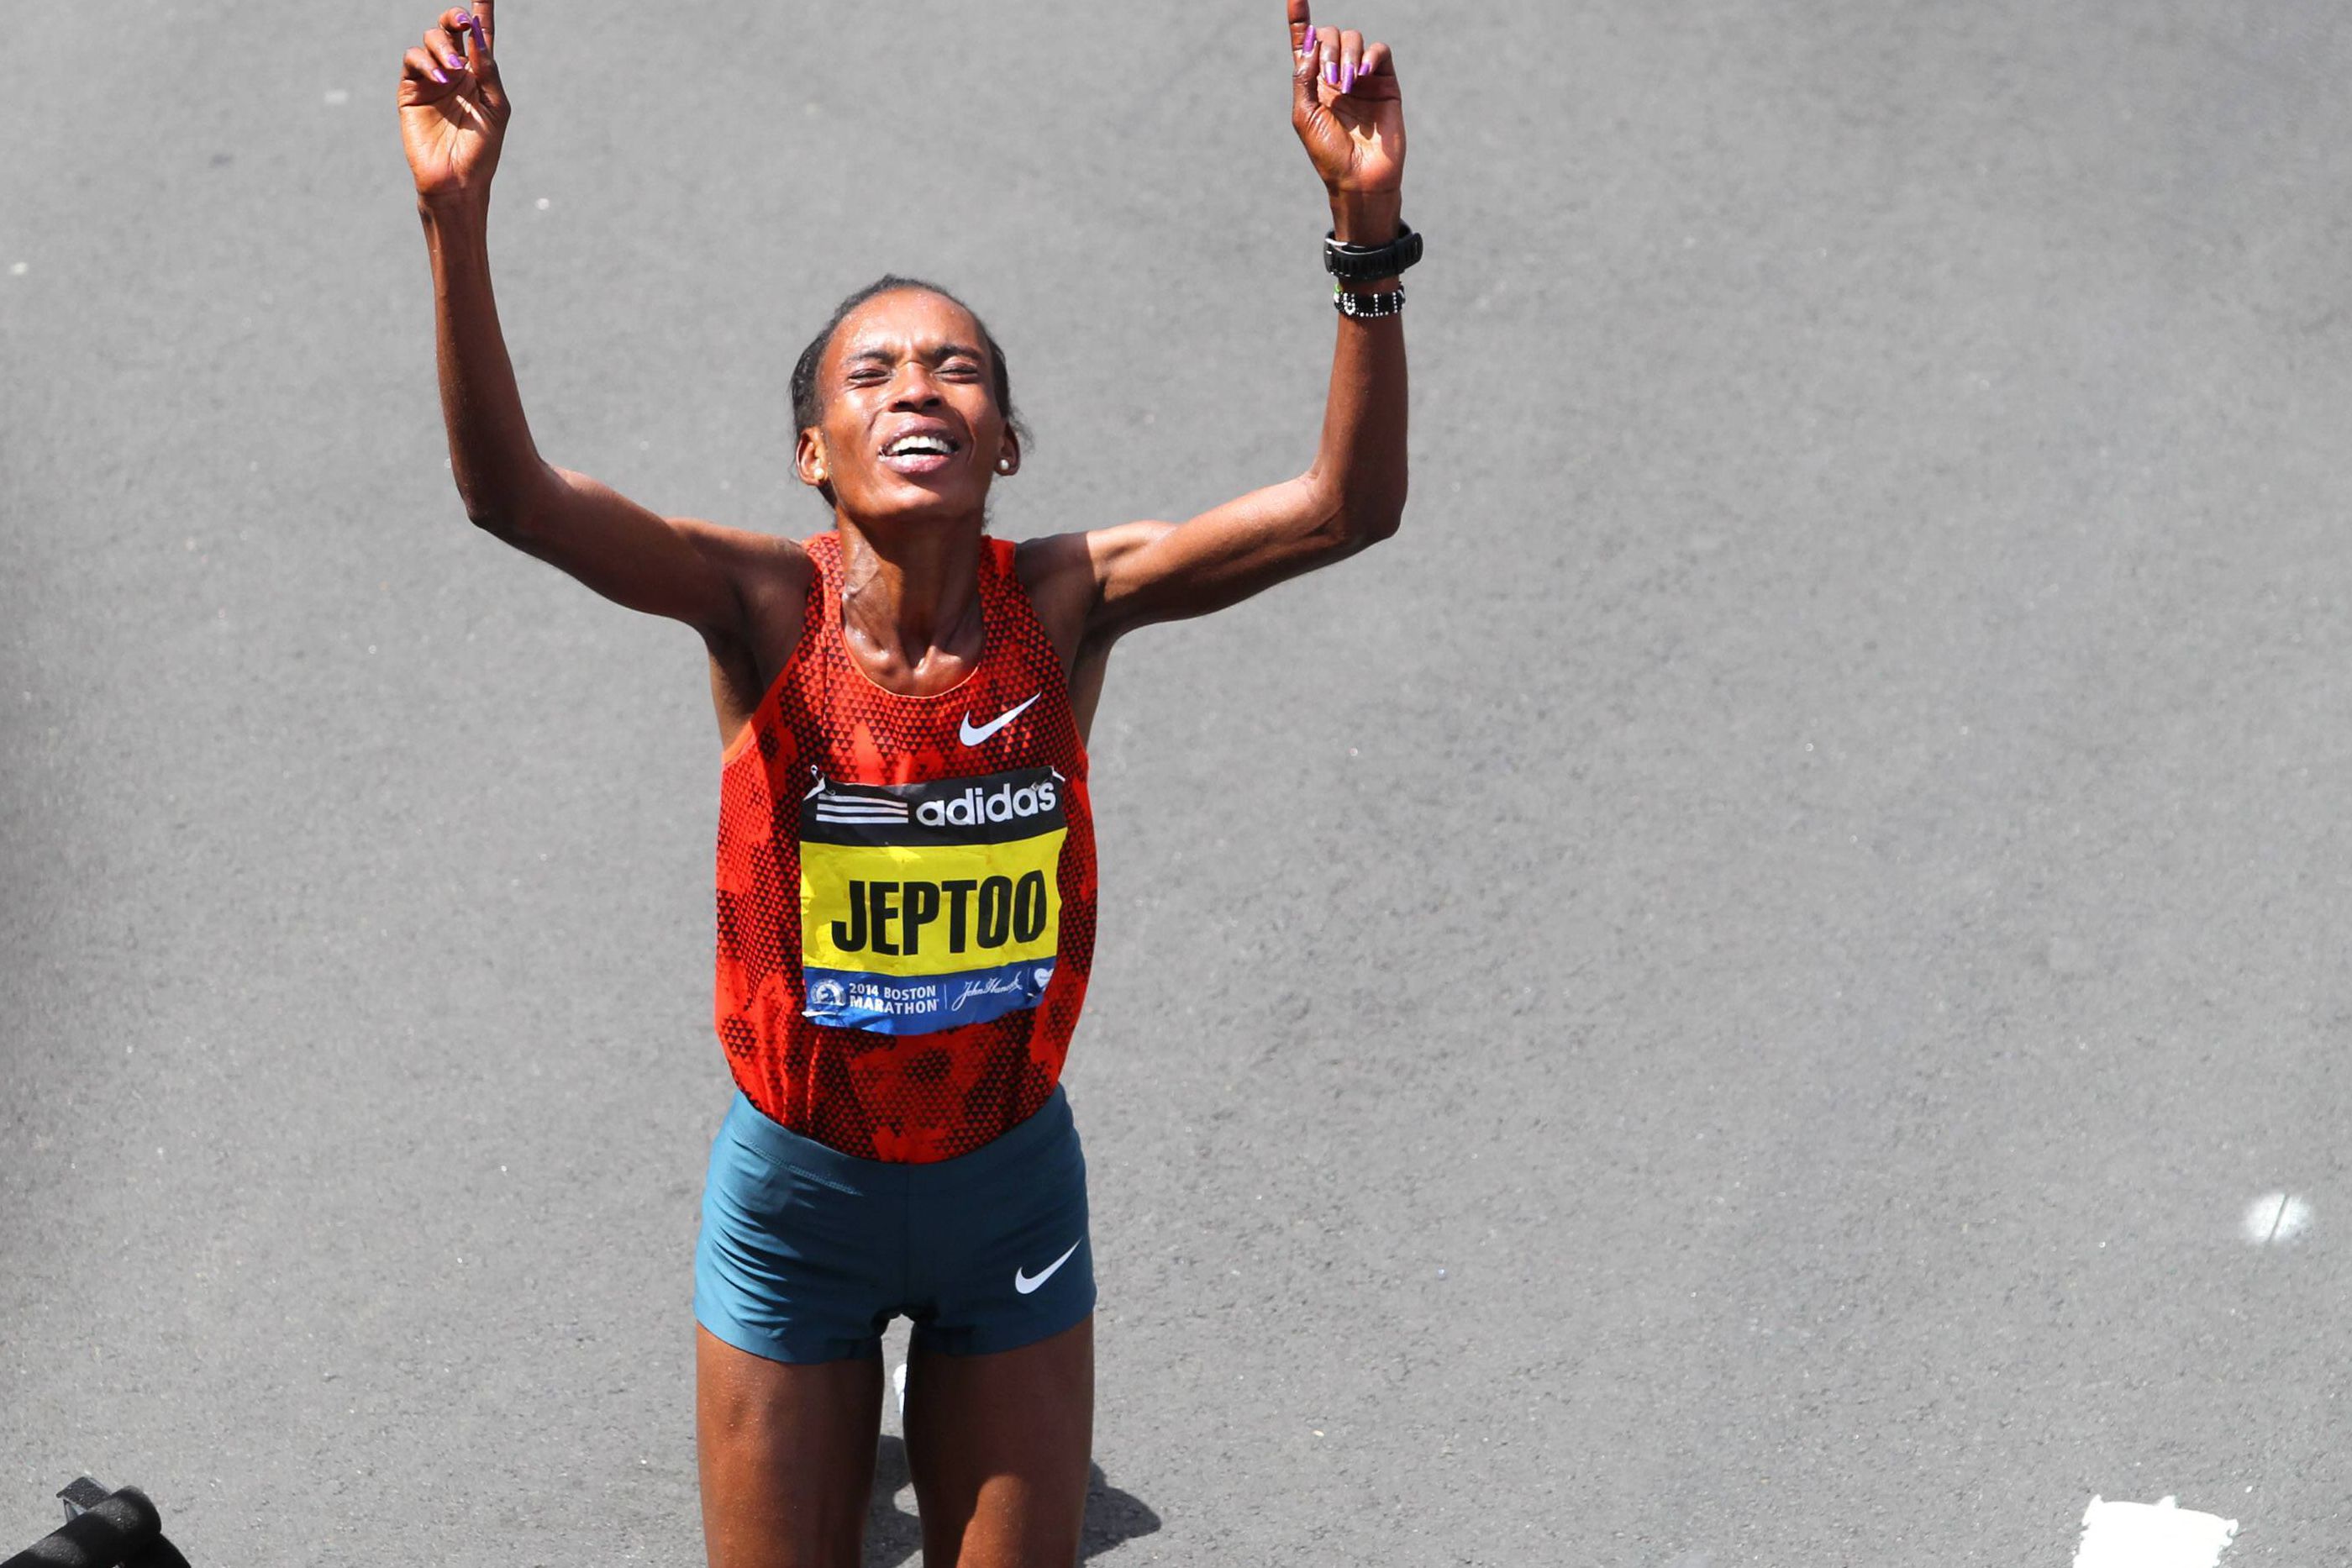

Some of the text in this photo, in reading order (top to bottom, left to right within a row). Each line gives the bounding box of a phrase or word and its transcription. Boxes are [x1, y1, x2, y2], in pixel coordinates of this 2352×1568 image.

[916, 781, 1056, 826] adidas
[831, 869, 1047, 956] JEPTOO
[849, 982, 936, 1001] 2014 BOSTON
[850, 995, 938, 1015] MARATHON
[951, 981, 986, 1011] John
